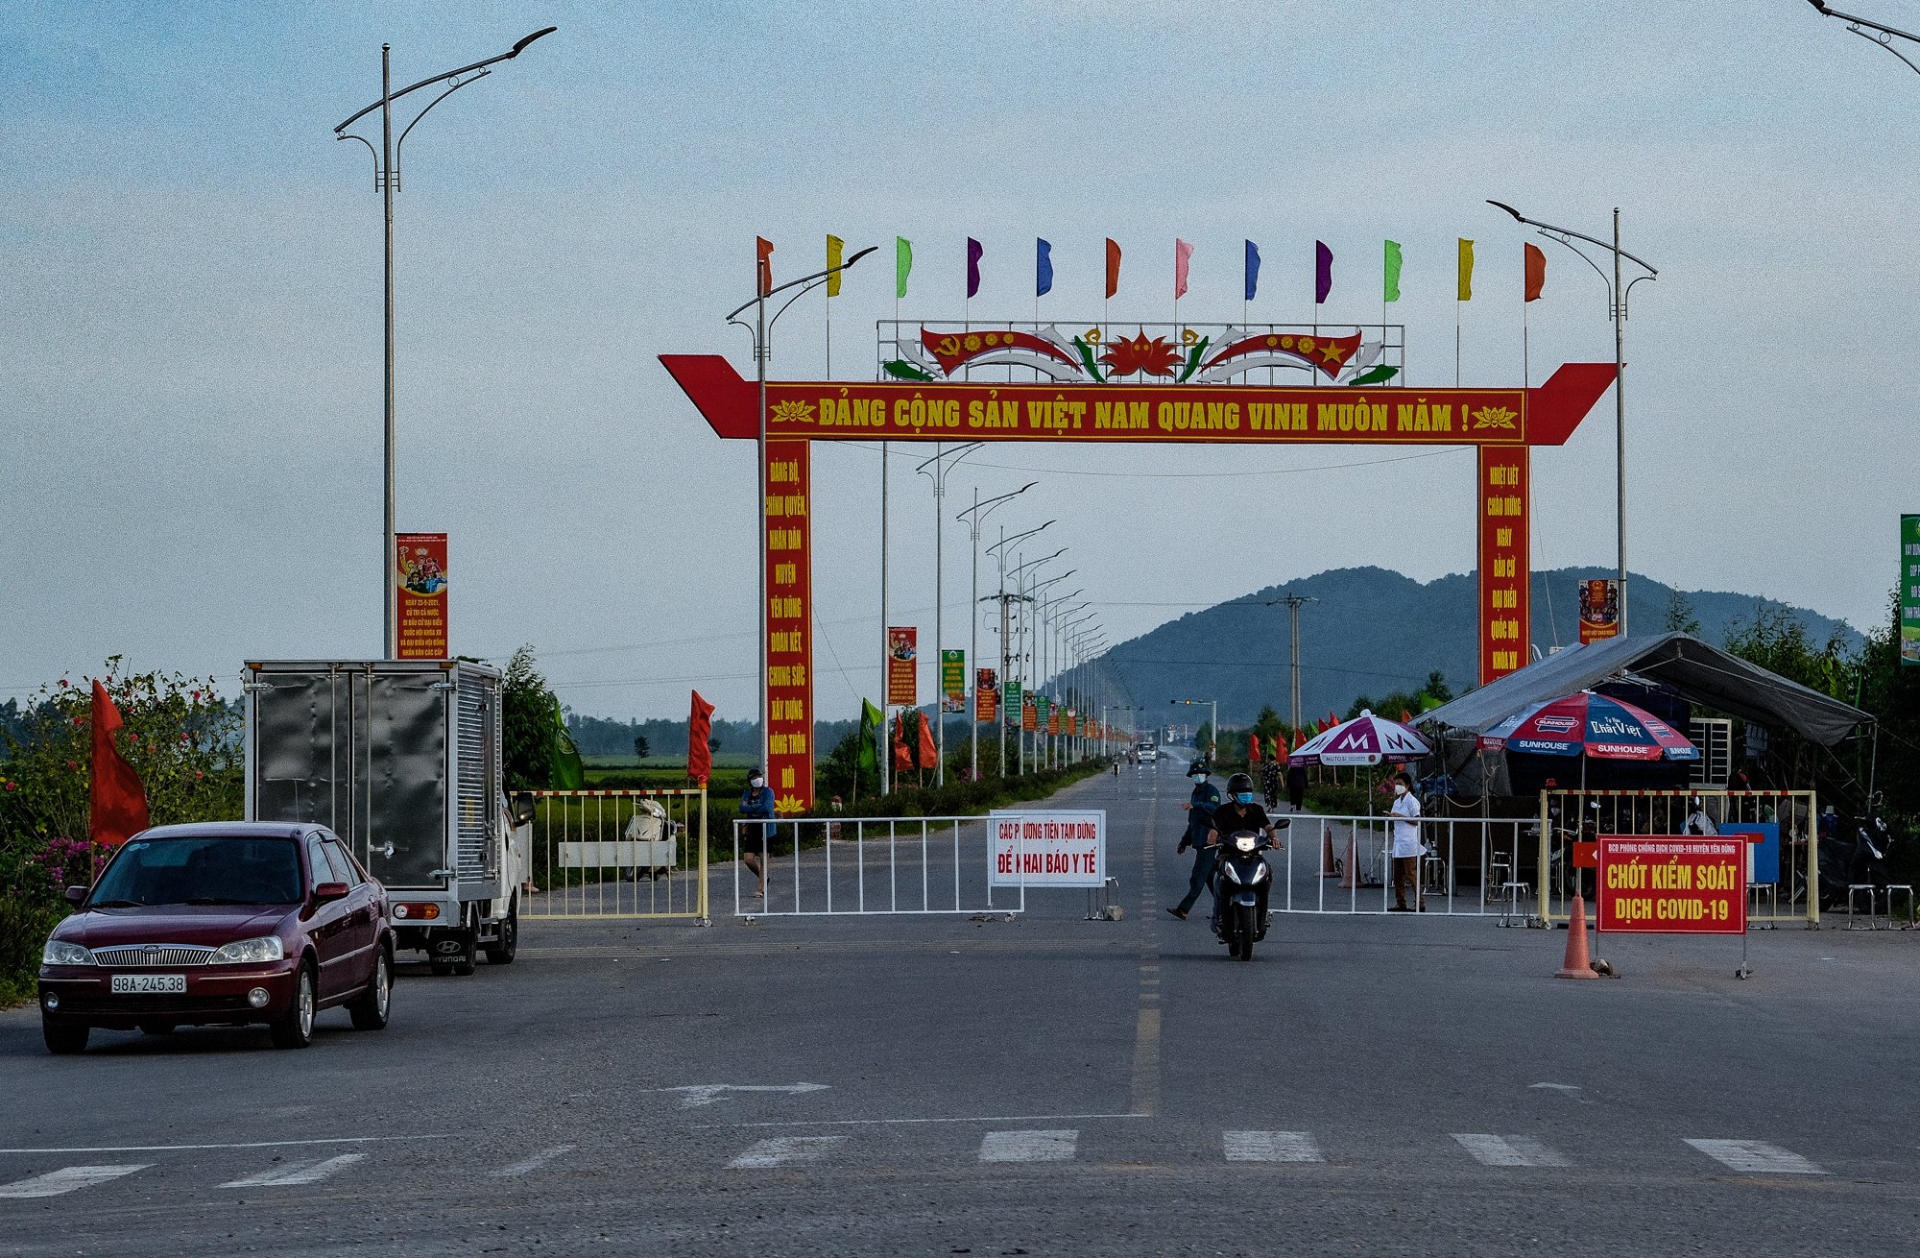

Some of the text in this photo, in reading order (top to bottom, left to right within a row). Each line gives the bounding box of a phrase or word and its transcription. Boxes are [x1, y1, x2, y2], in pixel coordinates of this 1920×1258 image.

[819, 388, 885, 428] ĐẢNG
[895, 392, 959, 434] CỘNG
[969, 389, 1018, 428] SẢN
[1028, 394, 1086, 436] VIỆT
[1095, 402, 1149, 430] NAM
[1158, 402, 1239, 432] QUANG
[1248, 403, 1308, 431] VINH
[1317, 397, 1387, 432] MUÔN
[1398, 398, 1451, 432] NĂM
[1497, 526, 1512, 547] NGÀY
[1509, 651, 1518, 670] XV
[769, 665, 791, 687] CHUNG
[1519, 740, 1569, 750] SUNHOUSE
[1598, 744, 1648, 754] SUNHOUSE
[999, 819, 1096, 843] CÁC PƯƠNG TIỆN TẠM DỪNG
[1669, 844, 1692, 853] COVID-19
[998, 845, 1013, 874] ĐỂ
[1046, 849, 1069, 874] BÁO
[1072, 853, 1080, 874] Y
[1083, 846, 1097, 874] TẾ
[1607, 854, 1737, 890] CHỐT KIỂM SOÁT
[1615, 898, 1729, 924] DỊCH COVID-19
[113, 977, 184, 991] 98A-245.38
